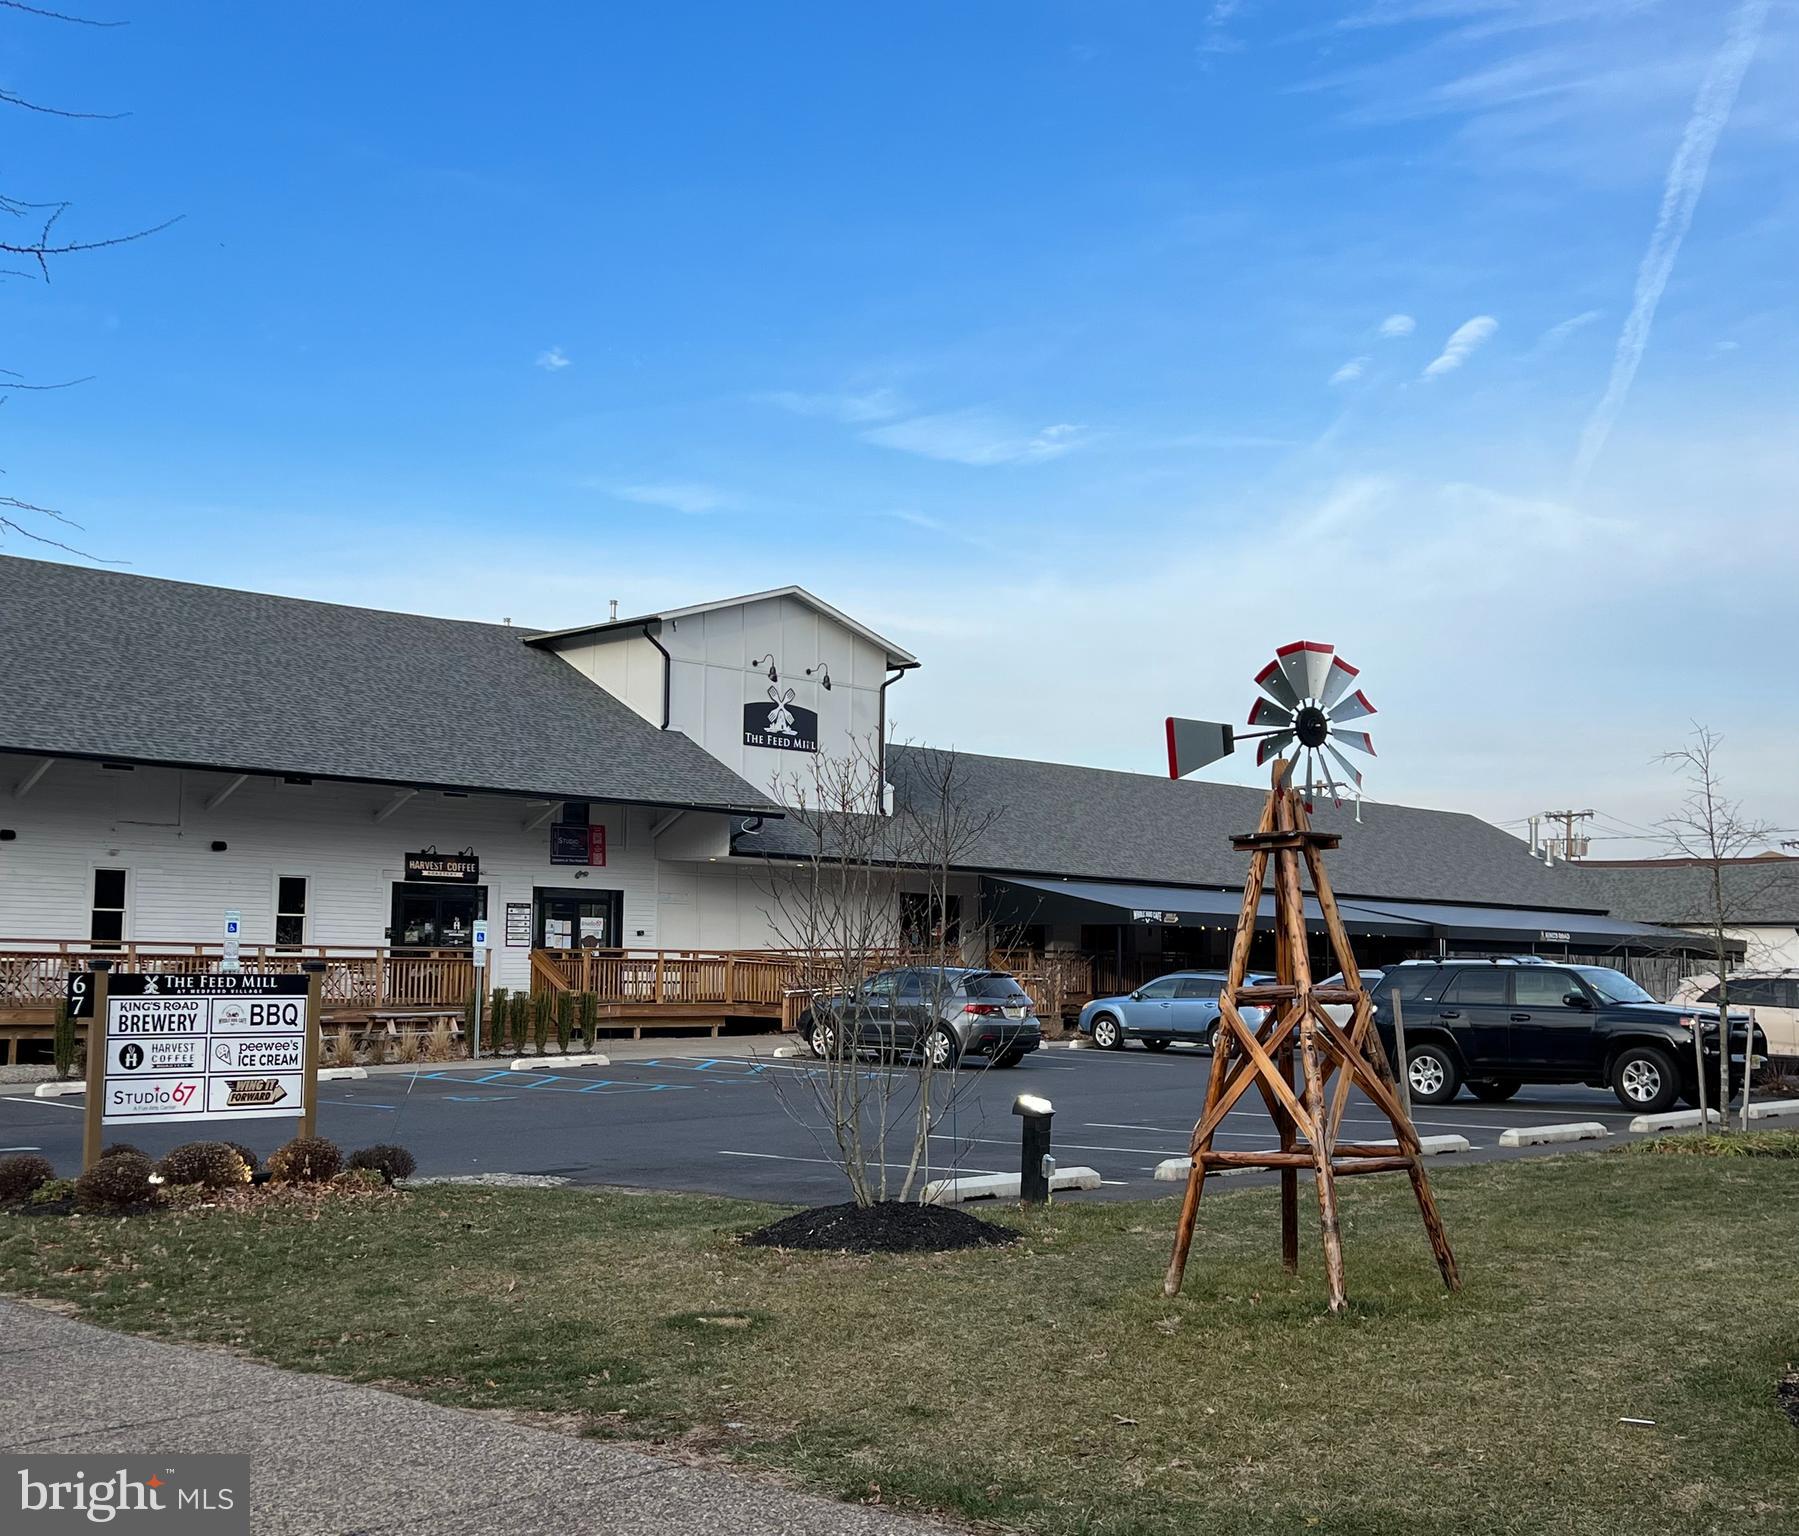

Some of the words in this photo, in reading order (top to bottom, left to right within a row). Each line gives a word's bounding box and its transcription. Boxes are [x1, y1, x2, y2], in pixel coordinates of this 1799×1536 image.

[745, 732, 764, 744] THE
[767, 735, 790, 747] FEED
[793, 738, 816, 750] MILL
[409, 860, 443, 871] HARVEST
[447, 862, 476, 873] COFFEE
[164, 975, 194, 988] THE
[200, 975, 237, 988] FEED
[242, 975, 278, 988] MILL
[120, 1002, 160, 1012] KING'S
[163, 1002, 199, 1011] ROAD
[250, 1003, 298, 1027] BBQ
[119, 1013, 197, 1032] BREWERY
[152, 1043, 195, 1053] HARVEST
[239, 1040, 299, 1054] peewee's
[152, 1054, 195, 1063] COFFEE
[238, 1055, 256, 1067] ICE
[259, 1054, 299, 1066] CREAM
[236, 1080, 264, 1091] WING
[264, 1079, 278, 1091] IT
[172, 1081, 197, 1106] 67
[230, 1092, 271, 1102] FORWARD
